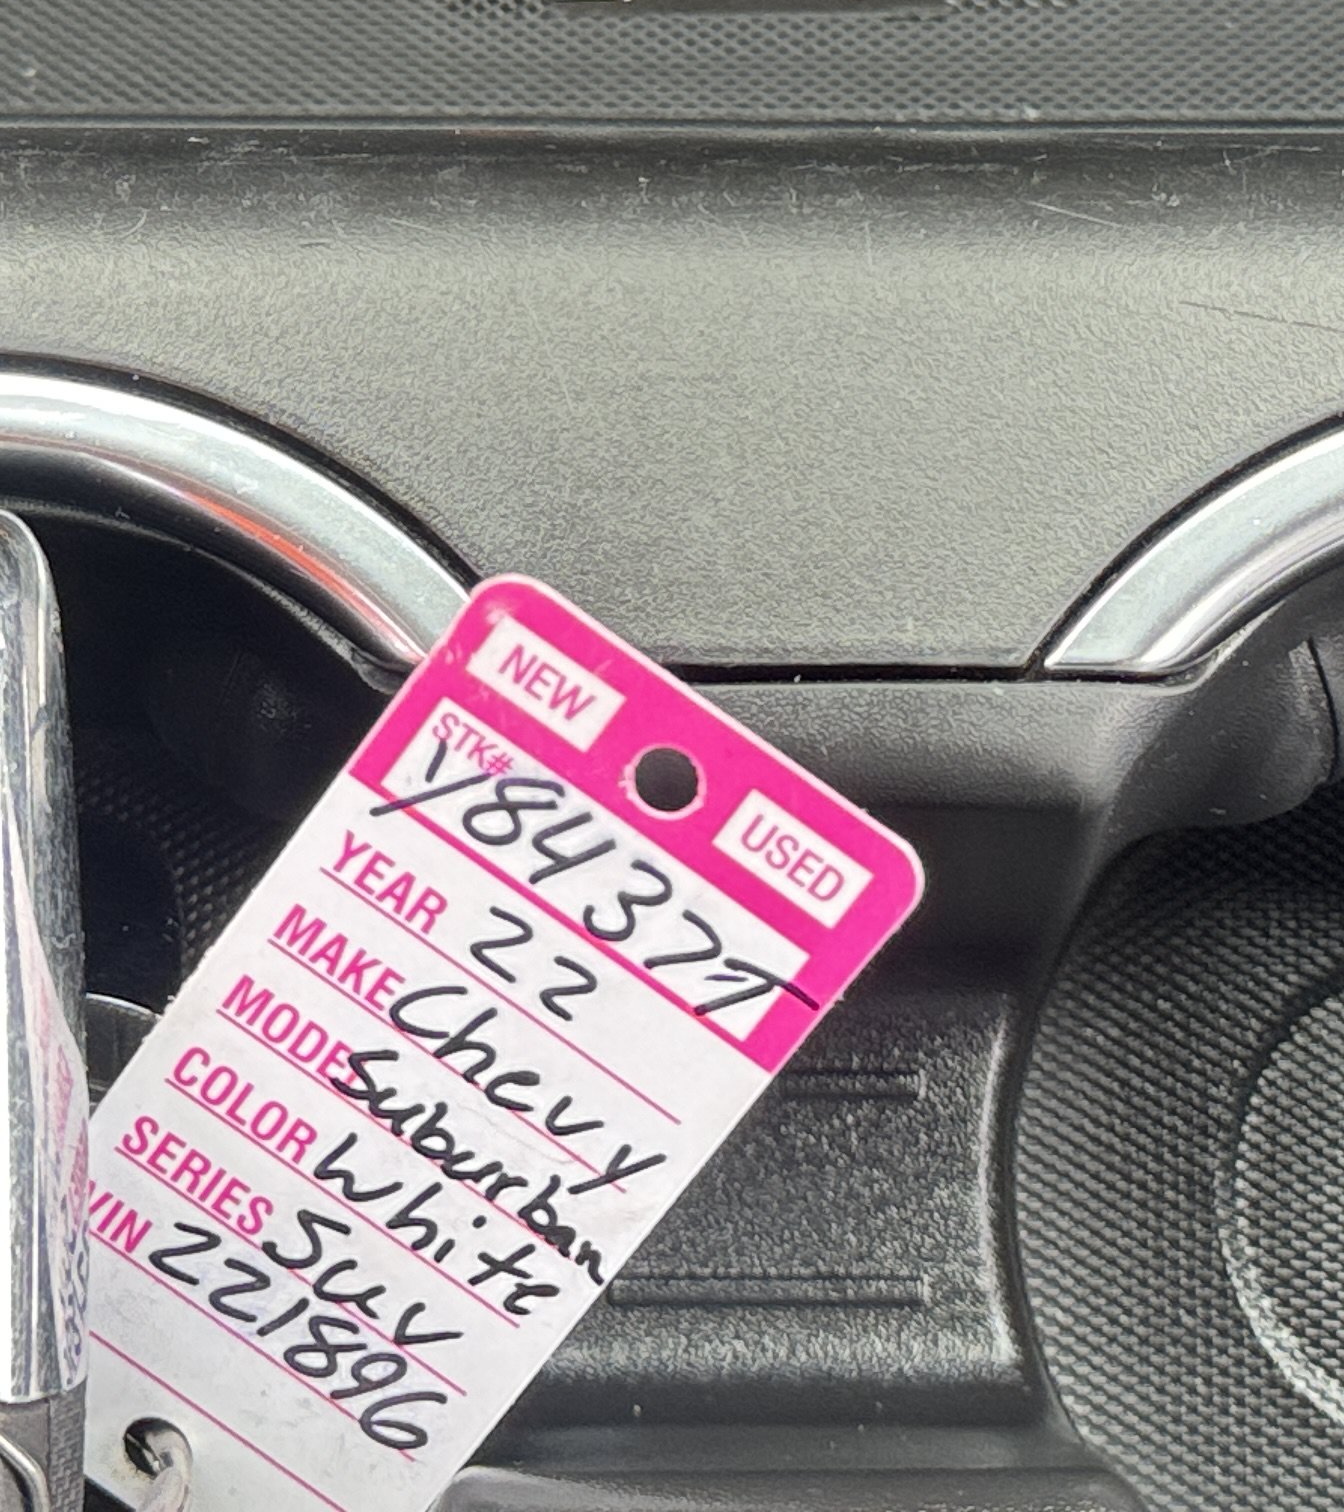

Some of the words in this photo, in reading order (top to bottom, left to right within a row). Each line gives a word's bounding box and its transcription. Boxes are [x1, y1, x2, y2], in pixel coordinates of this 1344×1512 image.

[497, 642, 596, 723] NEW
[431, 711, 515, 777] STK#
[741, 812, 845, 904] USED
[331, 831, 448, 935] YEAR
[469, 905, 598, 1022] 22
[172, 1046, 319, 1168] COLOR
[273, 903, 397, 1010] MAKE
[389, 983, 666, 1197] Chevy
[123, 1116, 275, 1237] SERIES
[330, 1049, 606, 1288] Suburban
[149, 1221, 448, 1451] 221896
